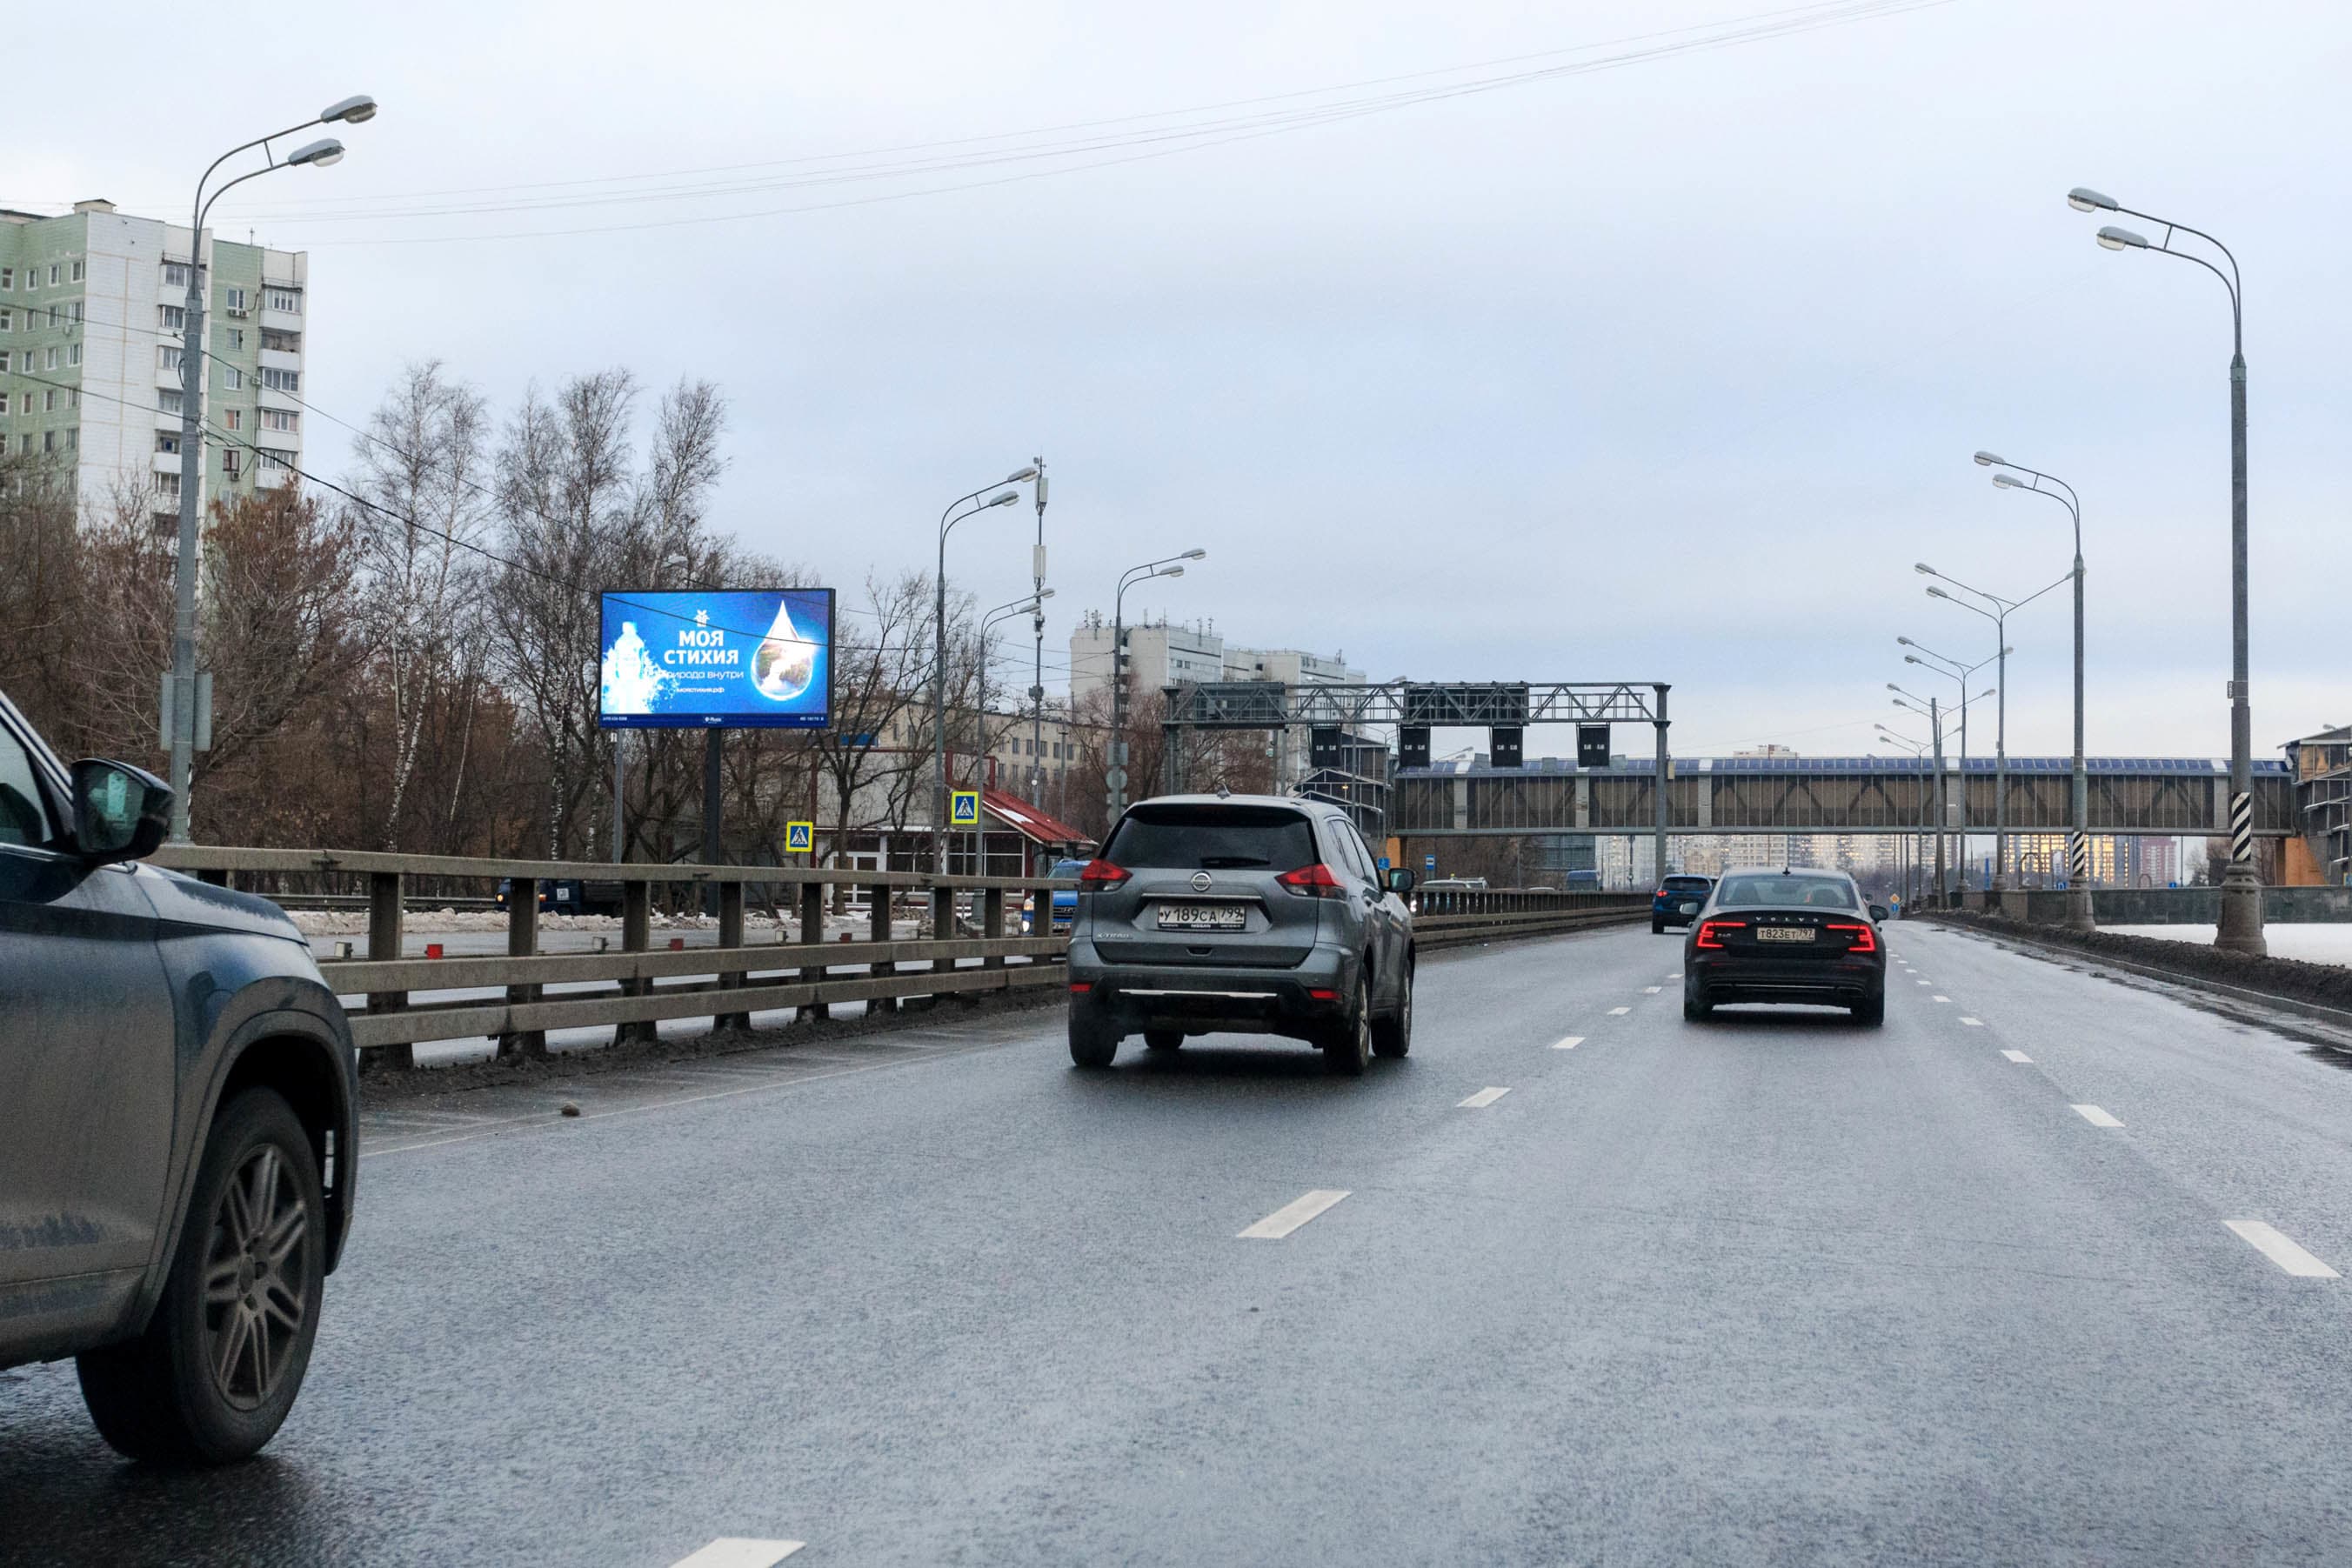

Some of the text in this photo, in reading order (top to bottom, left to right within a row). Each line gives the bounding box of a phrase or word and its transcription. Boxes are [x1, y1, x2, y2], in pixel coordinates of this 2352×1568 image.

[678, 630, 725, 647] МОЯ
[664, 649, 738, 665] СТИХИЯ
[662, 671, 745, 681] рирода внутри
[1164, 907, 1242, 922] У189СА 799
